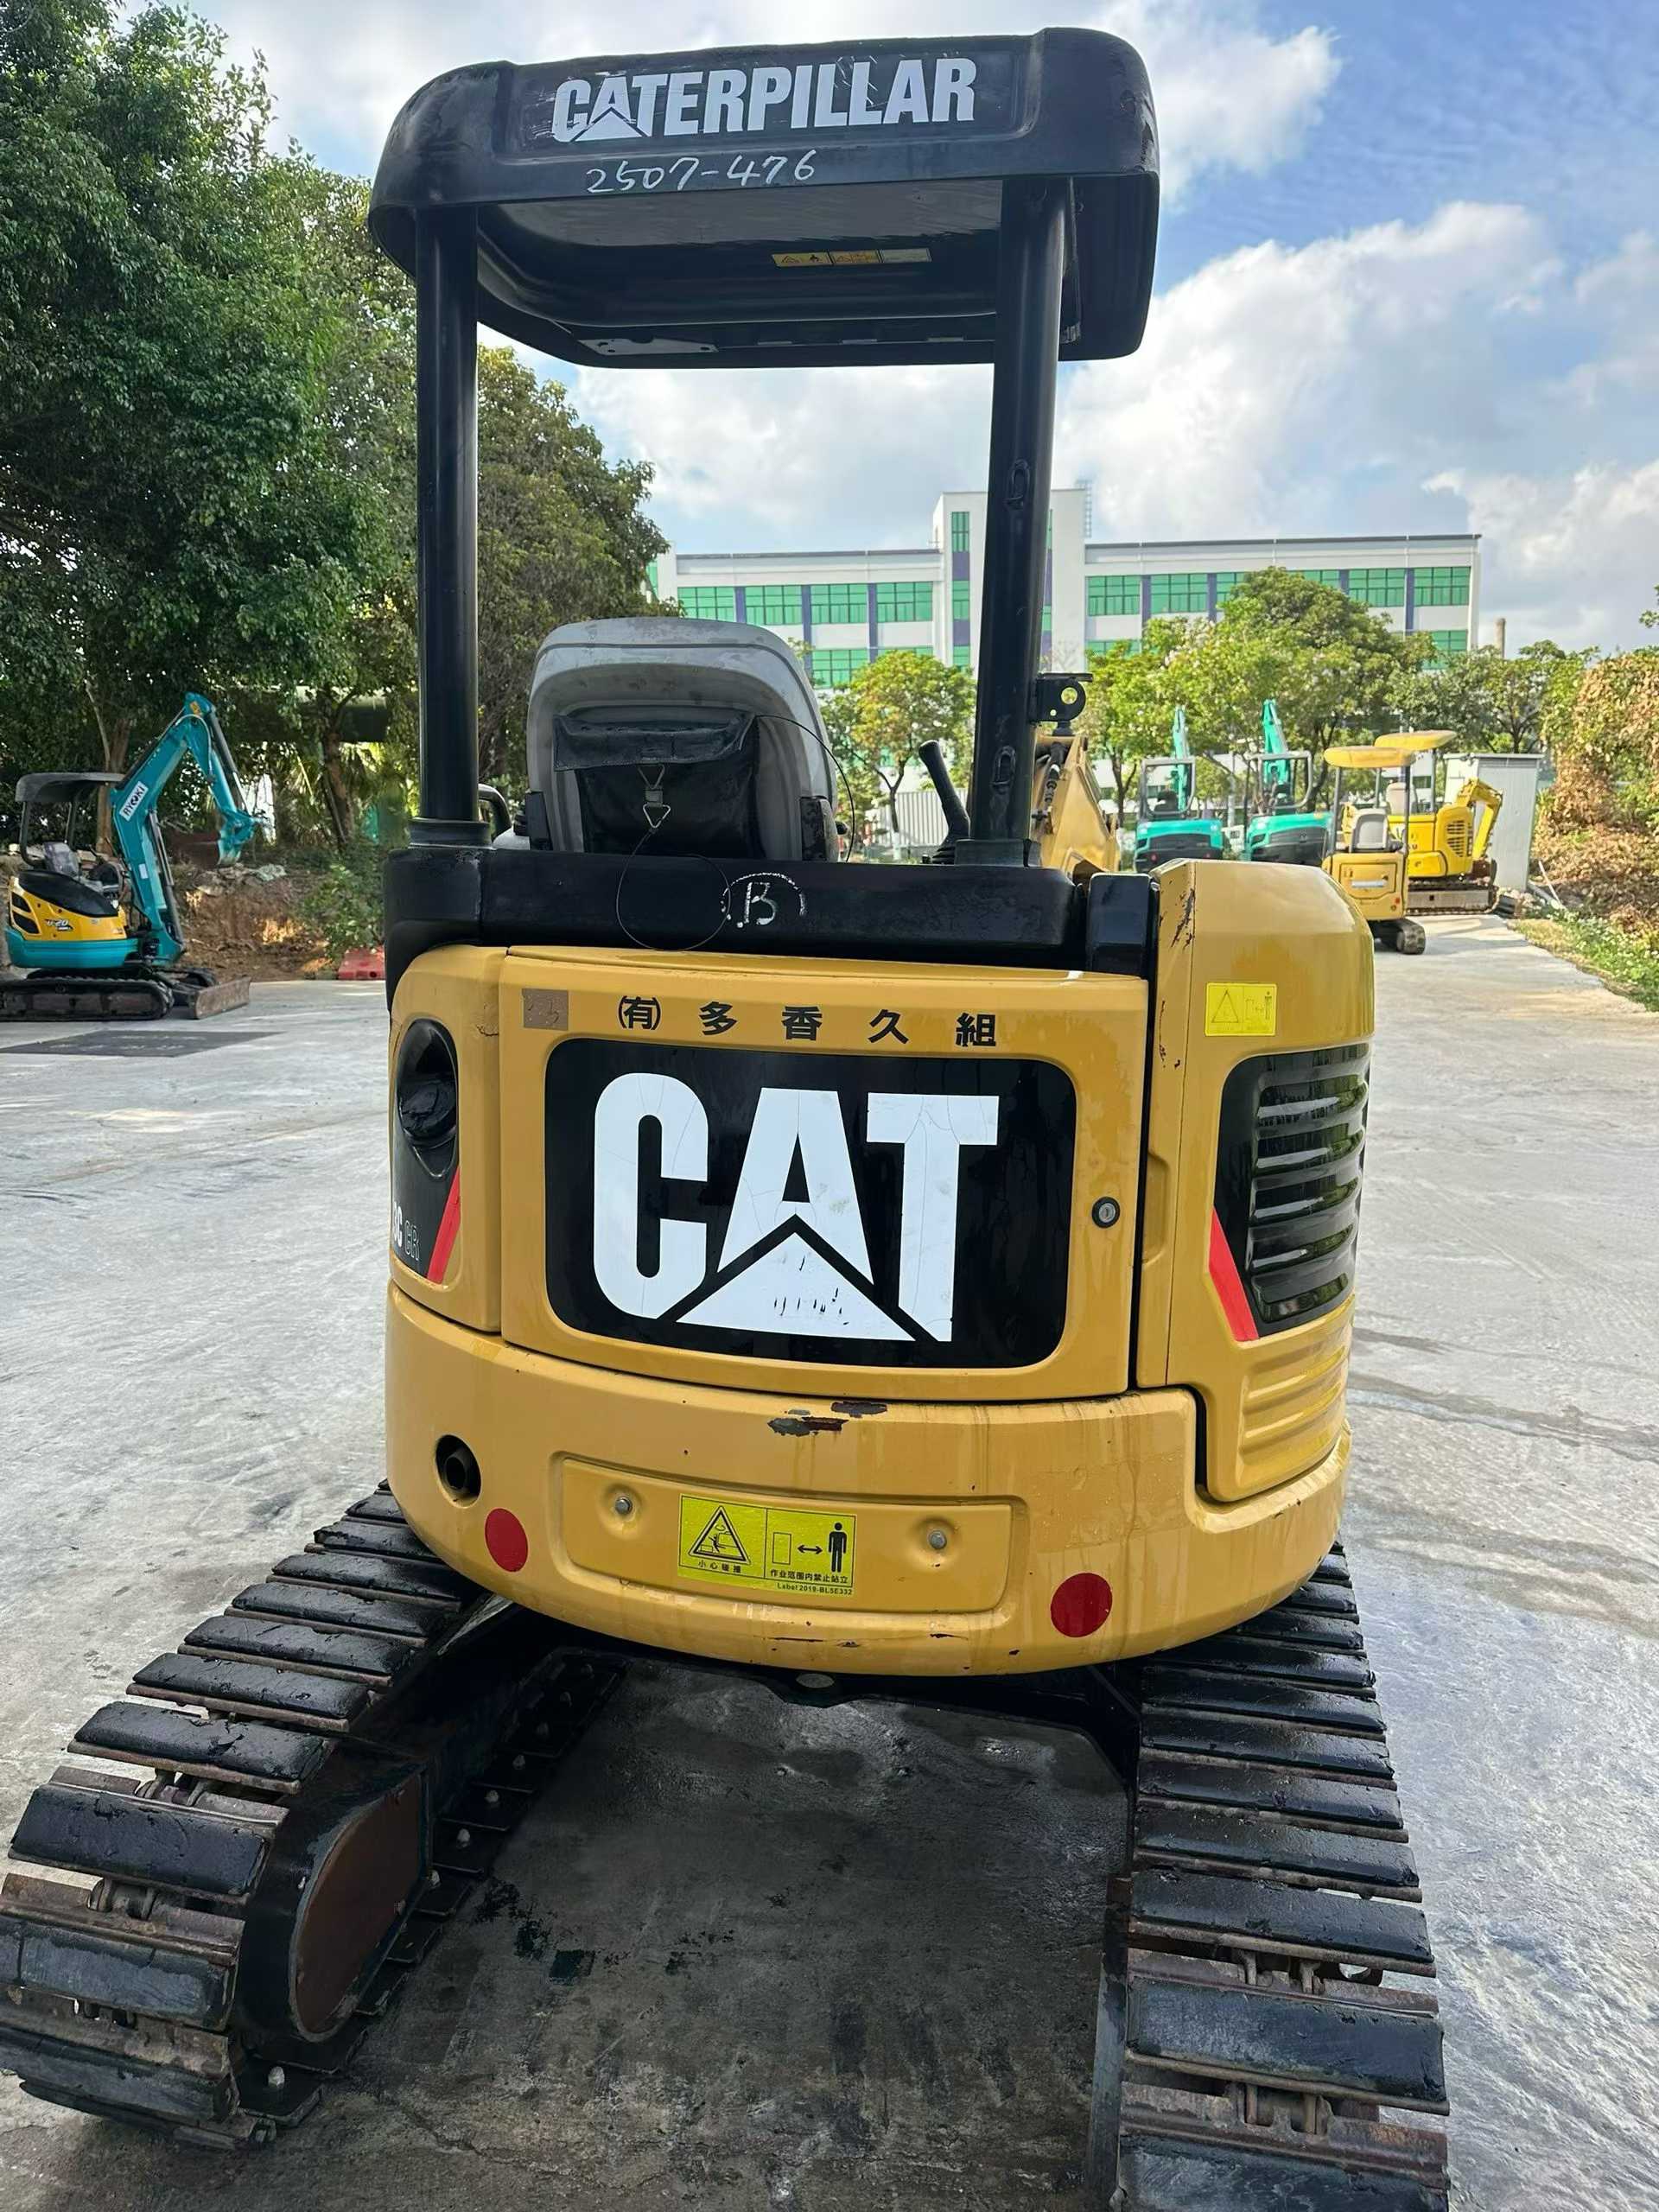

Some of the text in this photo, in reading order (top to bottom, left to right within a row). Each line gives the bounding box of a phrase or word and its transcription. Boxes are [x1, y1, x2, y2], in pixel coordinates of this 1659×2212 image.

[552, 57, 977, 143] CATERPILLAR
[586, 149, 817, 194] 2507-476
[742, 881, 777, 925] B
[593, 1071, 1000, 1343] CAT
